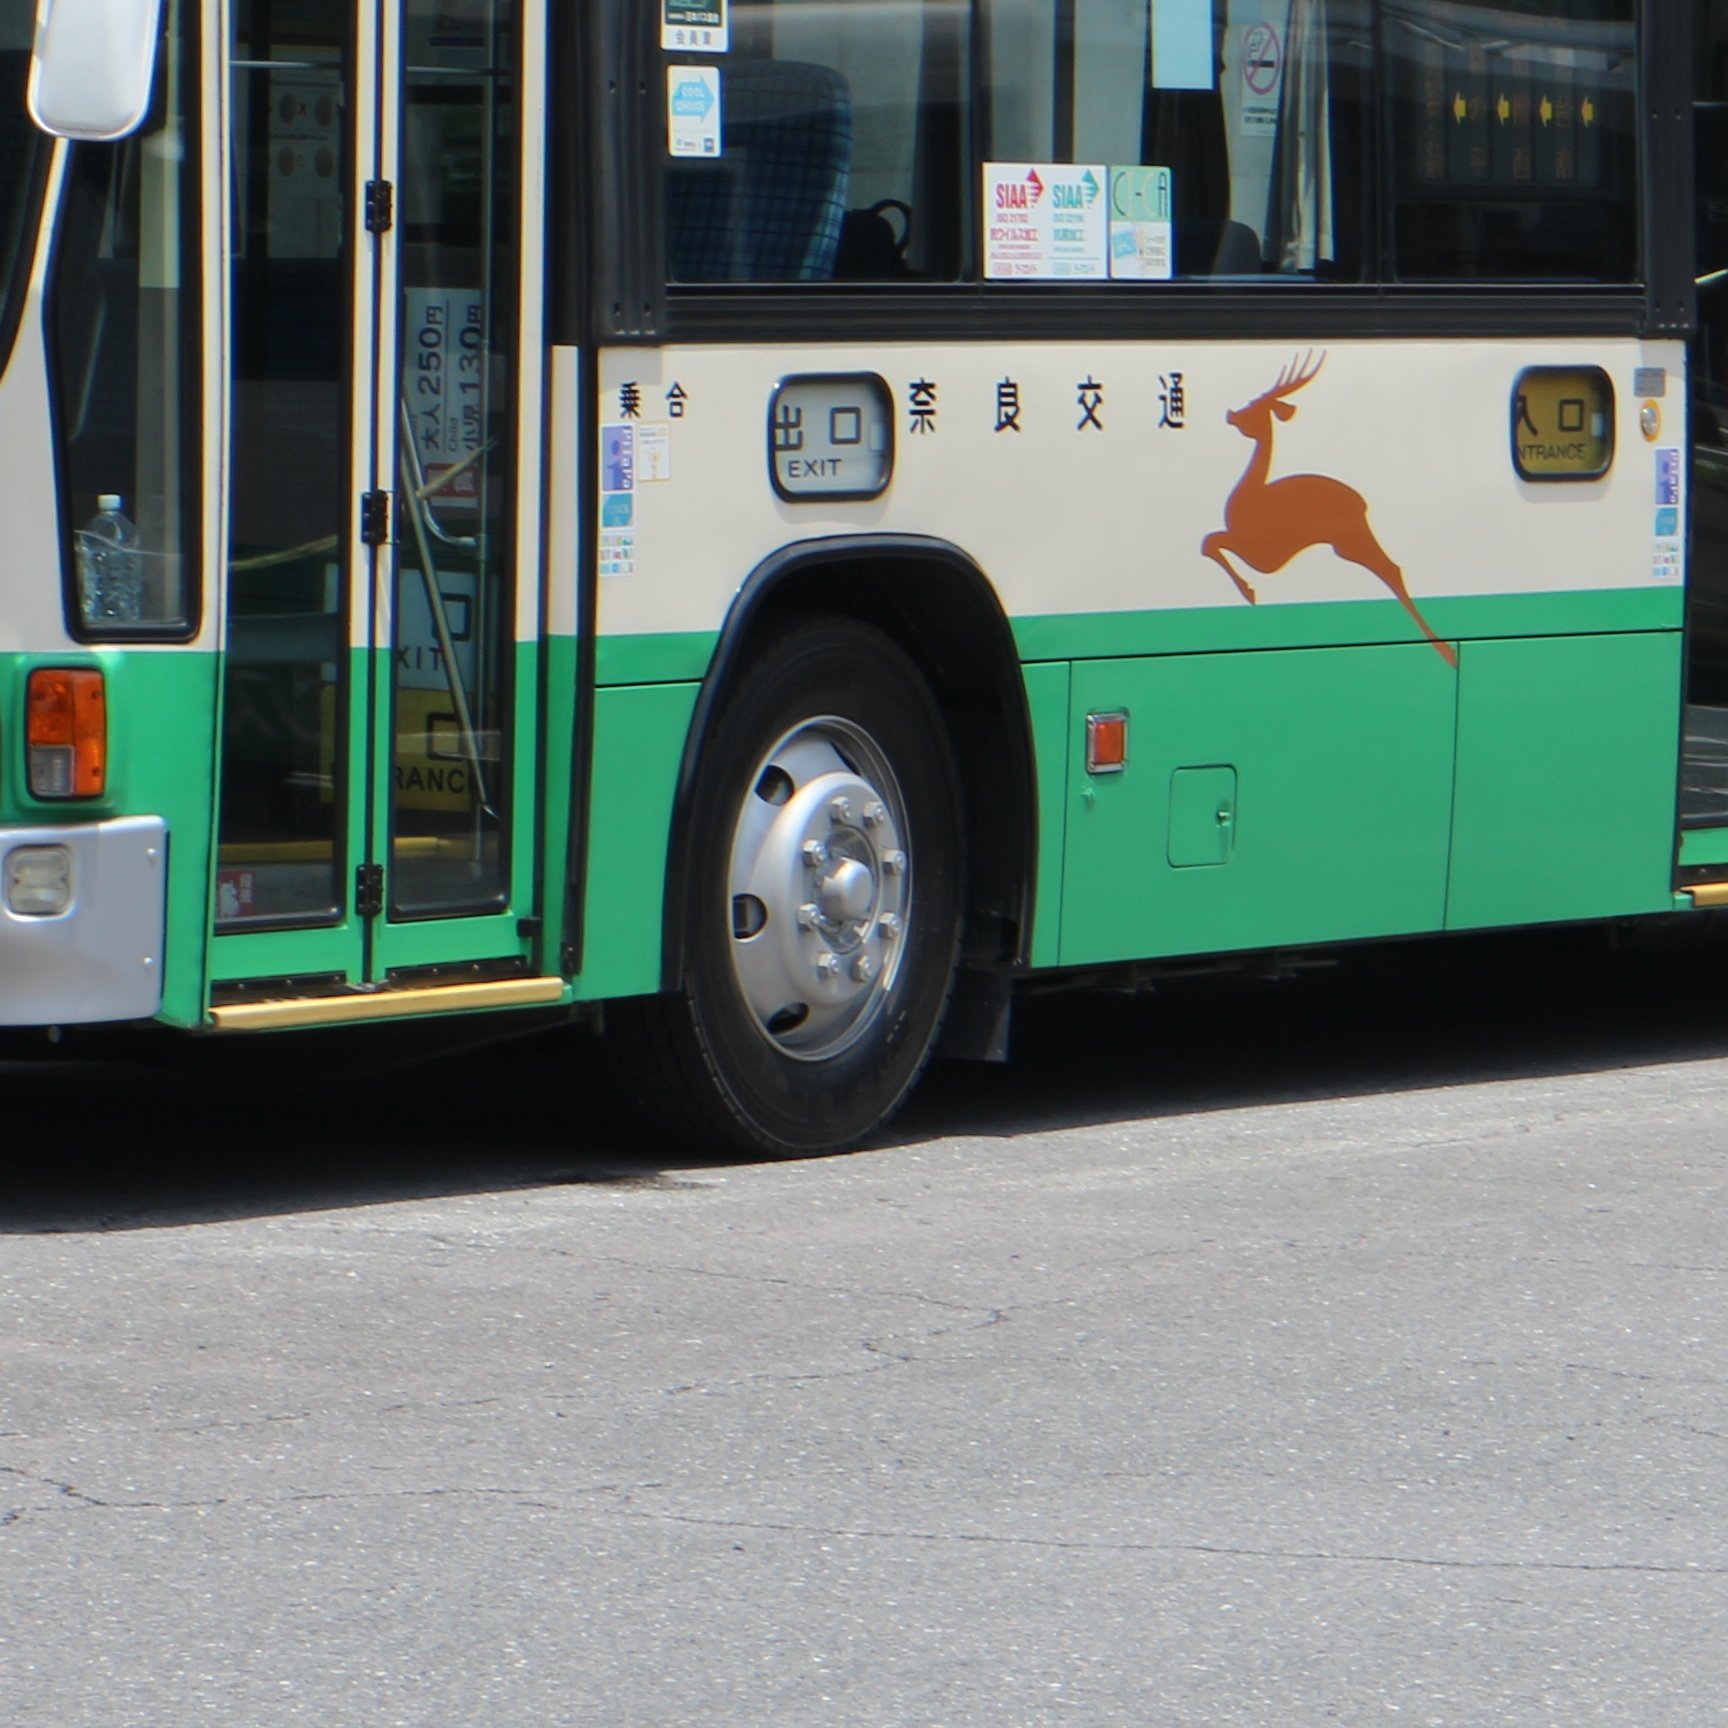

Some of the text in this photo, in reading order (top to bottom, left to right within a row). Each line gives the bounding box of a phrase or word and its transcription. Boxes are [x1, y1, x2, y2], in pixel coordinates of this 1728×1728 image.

[996, 183, 1027, 208] SIAA
[1053, 184, 1084, 208] SIAA
[909, 373, 1185, 435] 奈良交通
[774, 404, 861, 451] 出口
[1519, 443, 1587, 461] NTRANCE
[788, 459, 842, 478] EXIT
